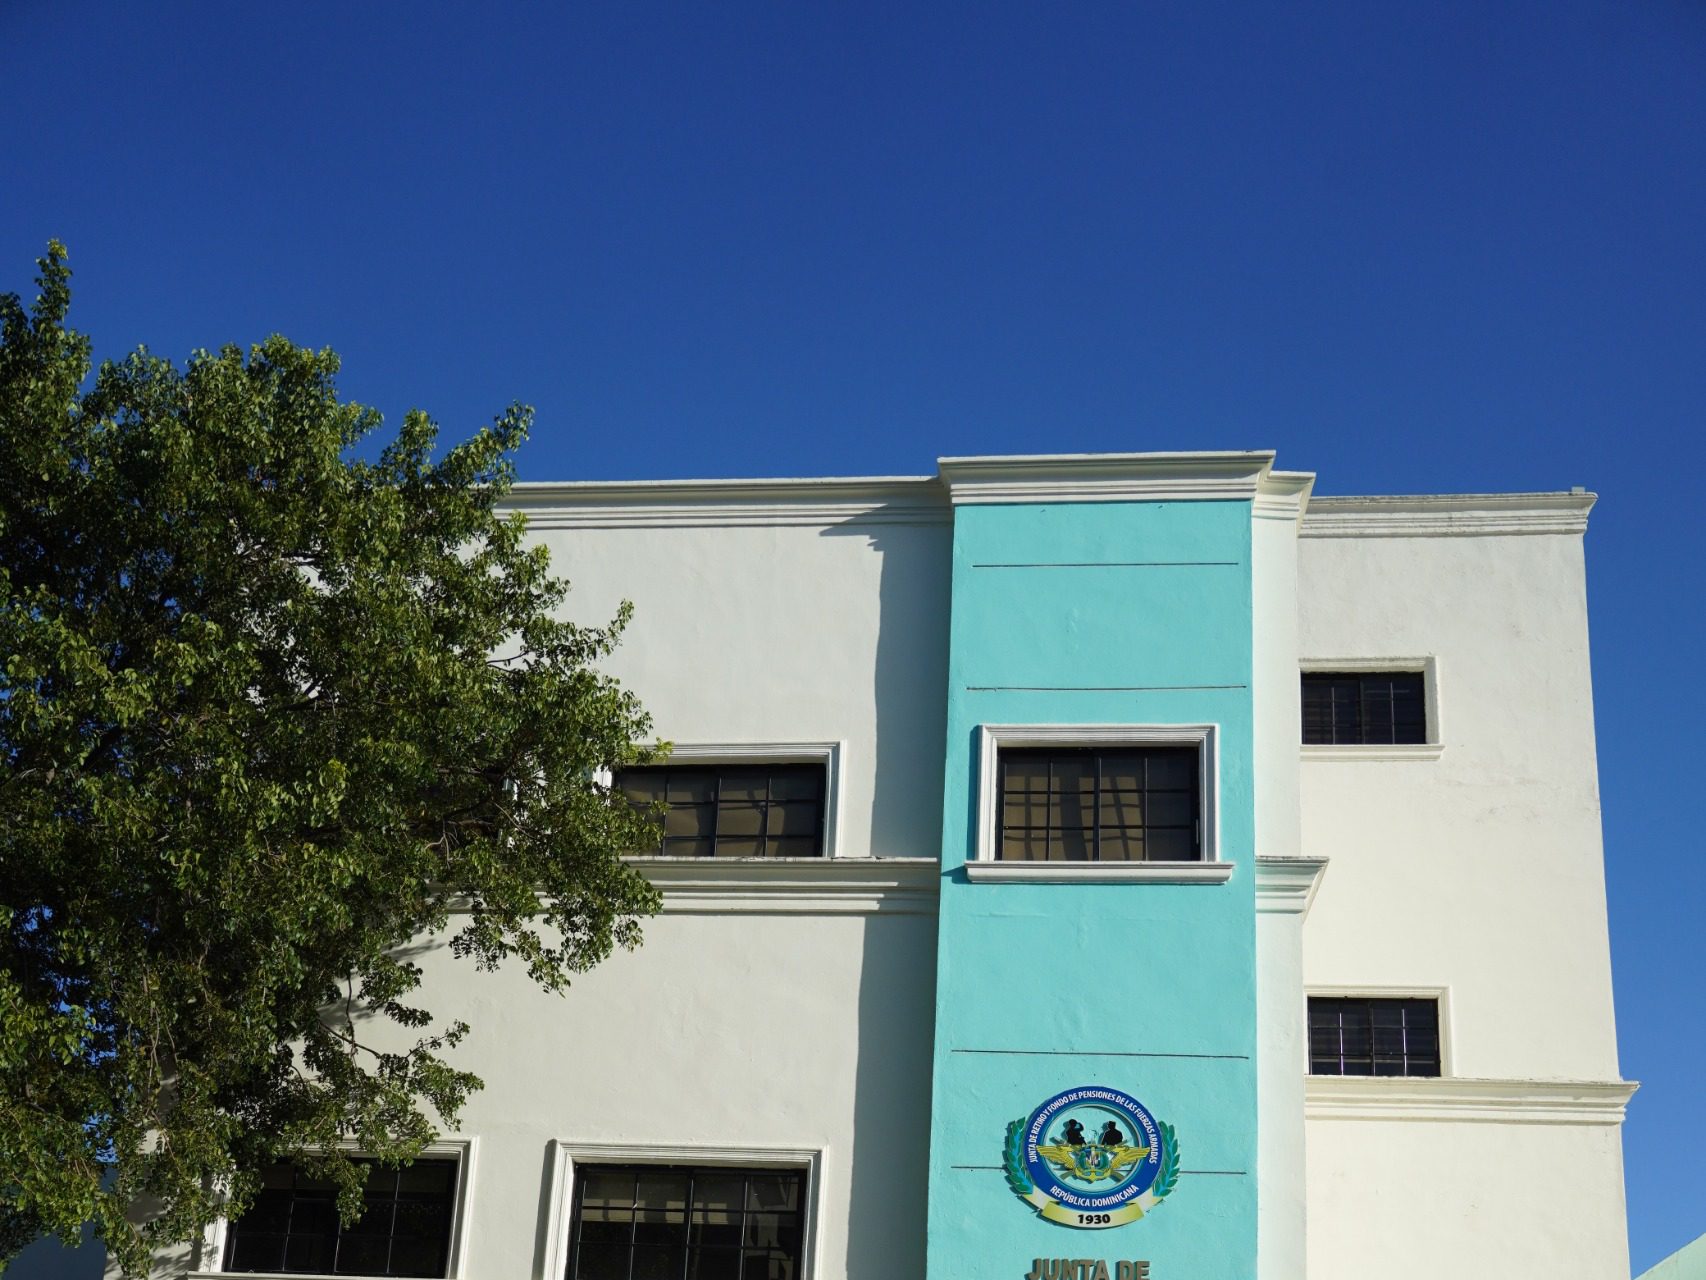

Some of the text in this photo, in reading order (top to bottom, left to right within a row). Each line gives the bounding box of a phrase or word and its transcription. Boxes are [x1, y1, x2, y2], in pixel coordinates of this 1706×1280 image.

[1068, 1092, 1079, 1102] DE
[1078, 1090, 1116, 1101] PENSIONES
[1115, 1095, 1126, 1105] DE
[1047, 1096, 1069, 1113] FONDO
[1123, 1099, 1138, 1112] LAS
[1031, 1113, 1047, 1135] RETIRO
[1133, 1107, 1155, 1134] FUERZAS
[1028, 1142, 1038, 1163] JUNTA
[1148, 1133, 1159, 1165] ARMADAS
[1049, 1184, 1139, 1207] REPÚBLICA DOMINICANA
[1078, 1213, 1111, 1225] 1930
